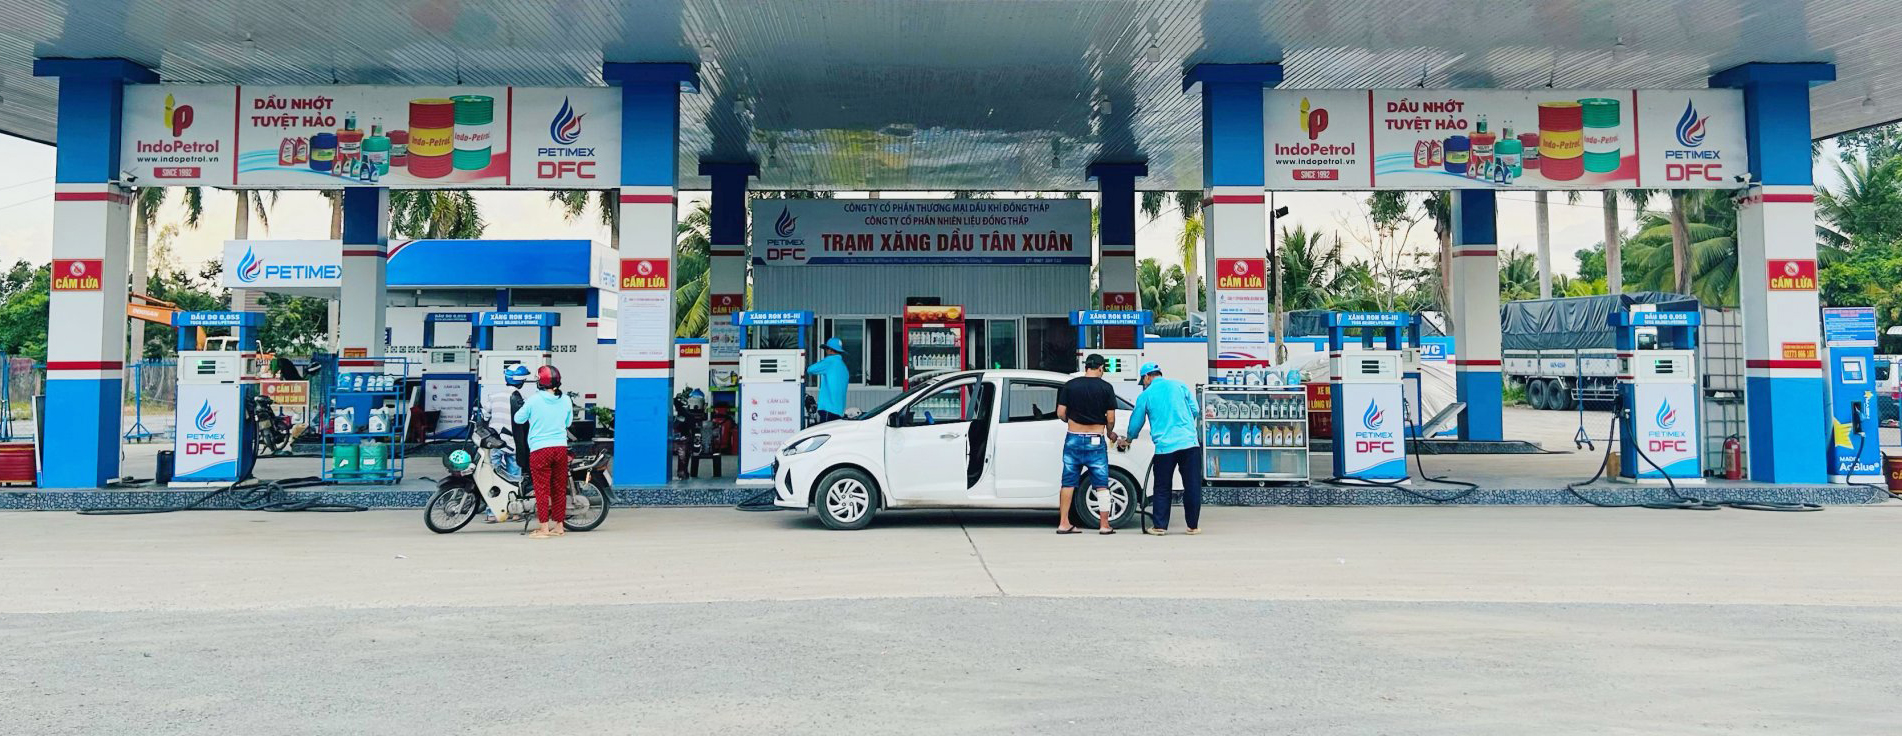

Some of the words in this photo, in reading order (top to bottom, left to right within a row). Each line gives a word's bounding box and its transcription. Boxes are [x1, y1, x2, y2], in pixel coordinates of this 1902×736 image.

[254, 94, 286, 110] DẦU
[290, 95, 334, 110] NHỚT
[1387, 98, 1419, 113] DẦU
[1423, 99, 1464, 113] NHỚT
[252, 113, 299, 130] TUYỆT
[302, 112, 336, 128] HẢO
[1385, 116, 1431, 133] TUYỆT
[1435, 114, 1468, 130] HẢO
[137, 140, 219, 152] IndoPetrol
[538, 148, 596, 156] PETIMEX
[1275, 143, 1355, 155] IndoPetrol
[1665, 150, 1720, 159] PETIMEX
[162, 168, 178, 177] SINCE
[179, 168, 193, 177] 1992
[538, 162, 596, 179] DFC
[1666, 164, 1722, 181] DFC
[844, 203, 867, 212] CÔNG
[869, 204, 878, 212] TY
[953, 204, 968, 214] MẠI
[865, 216, 887, 225] CÔNG
[889, 217, 899, 225] TY
[822, 234, 874, 255] TRẠM
[880, 230, 930, 251] XĂNG
[937, 228, 974, 251] DẦU
[980, 230, 1016, 251] TÂN
[1022, 230, 1072, 251] XUÂN
[767, 248, 806, 260] DFC
[55, 275, 78, 289] CẤM
[80, 275, 99, 289] LỬA
[623, 274, 645, 287] CẤM
[647, 274, 666, 287] LỬA
[1220, 274, 1241, 287] CẤM
[1244, 274, 1262, 287] LỬA
[1771, 276, 1792, 288] CẤM
[1795, 276, 1813, 288] LỬA
[1420, 344, 1440, 354] WC
[186, 443, 226, 454] DFC
[1356, 441, 1394, 453] DFC
[1649, 440, 1687, 452] DFC
